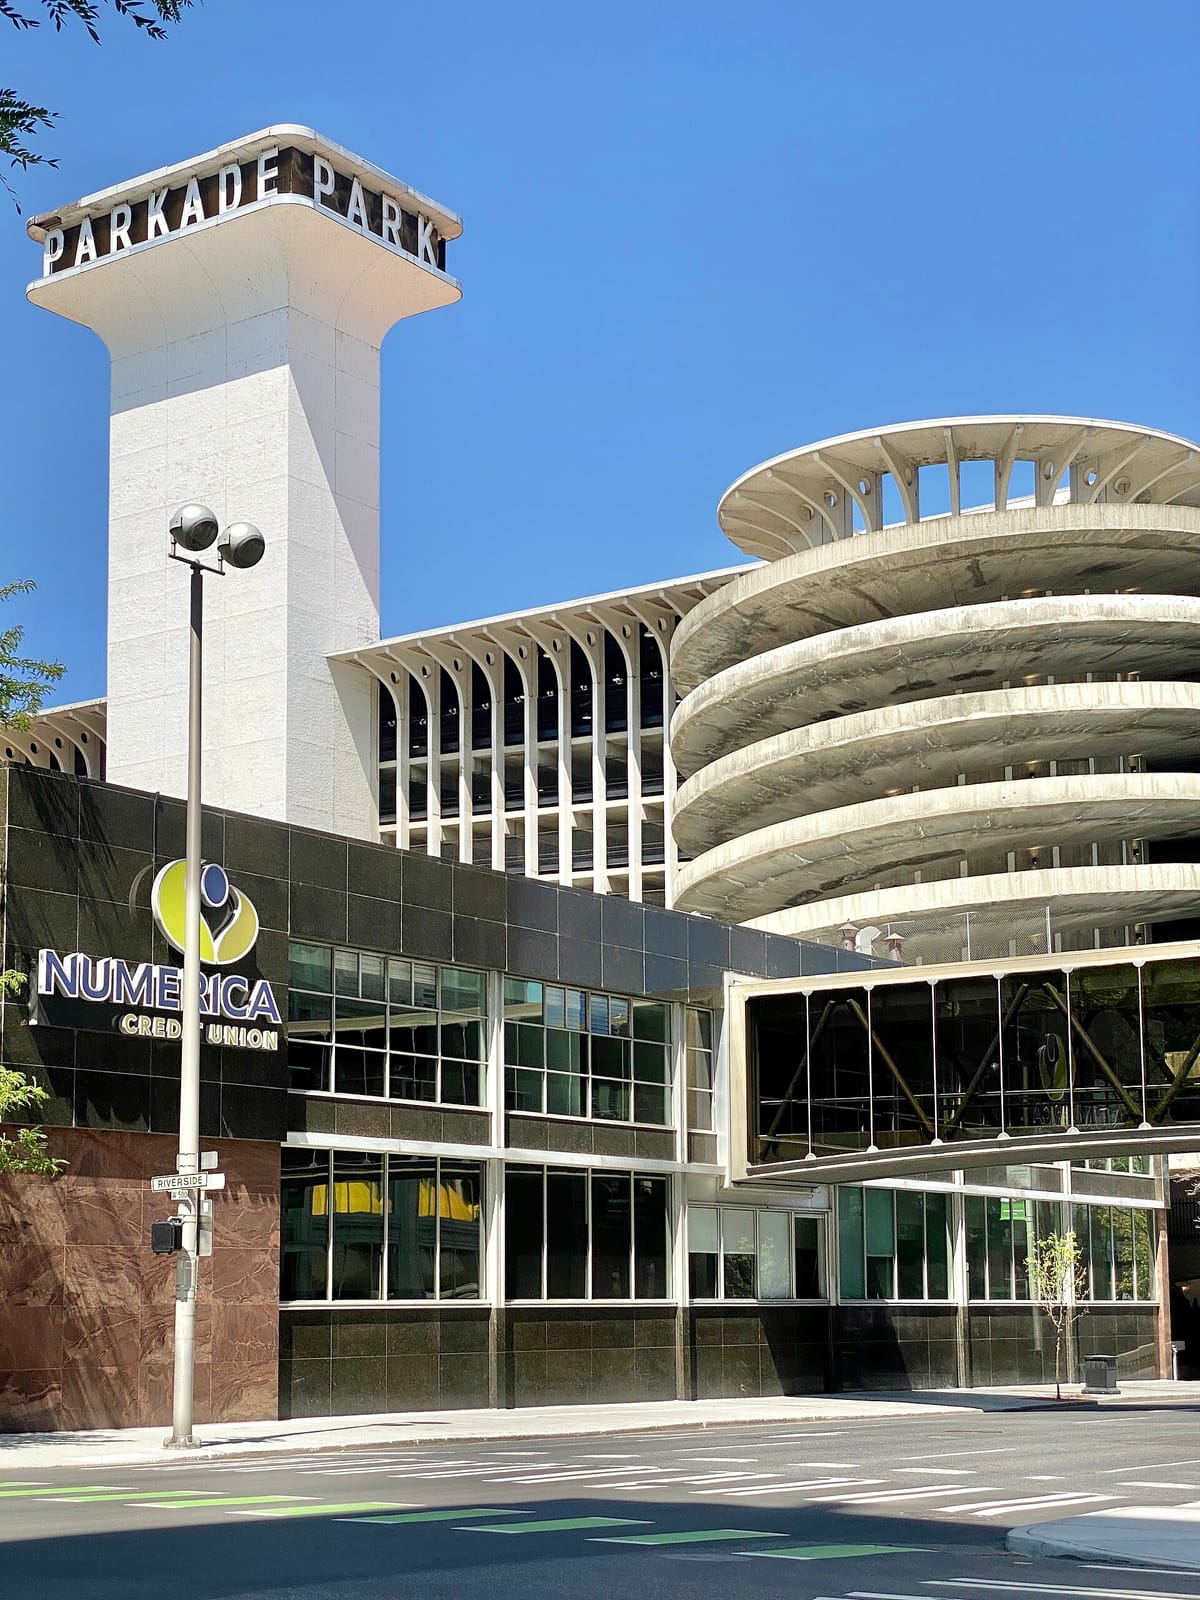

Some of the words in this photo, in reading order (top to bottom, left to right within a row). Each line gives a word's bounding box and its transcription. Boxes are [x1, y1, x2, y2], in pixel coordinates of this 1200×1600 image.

[43, 147, 279, 277] PARKADE
[314, 153, 438, 268] PARK
[120, 1013, 203, 1040] CRED
[207, 1024, 279, 1050] UNION
[157, 1175, 203, 1188] RIVERSIDE
